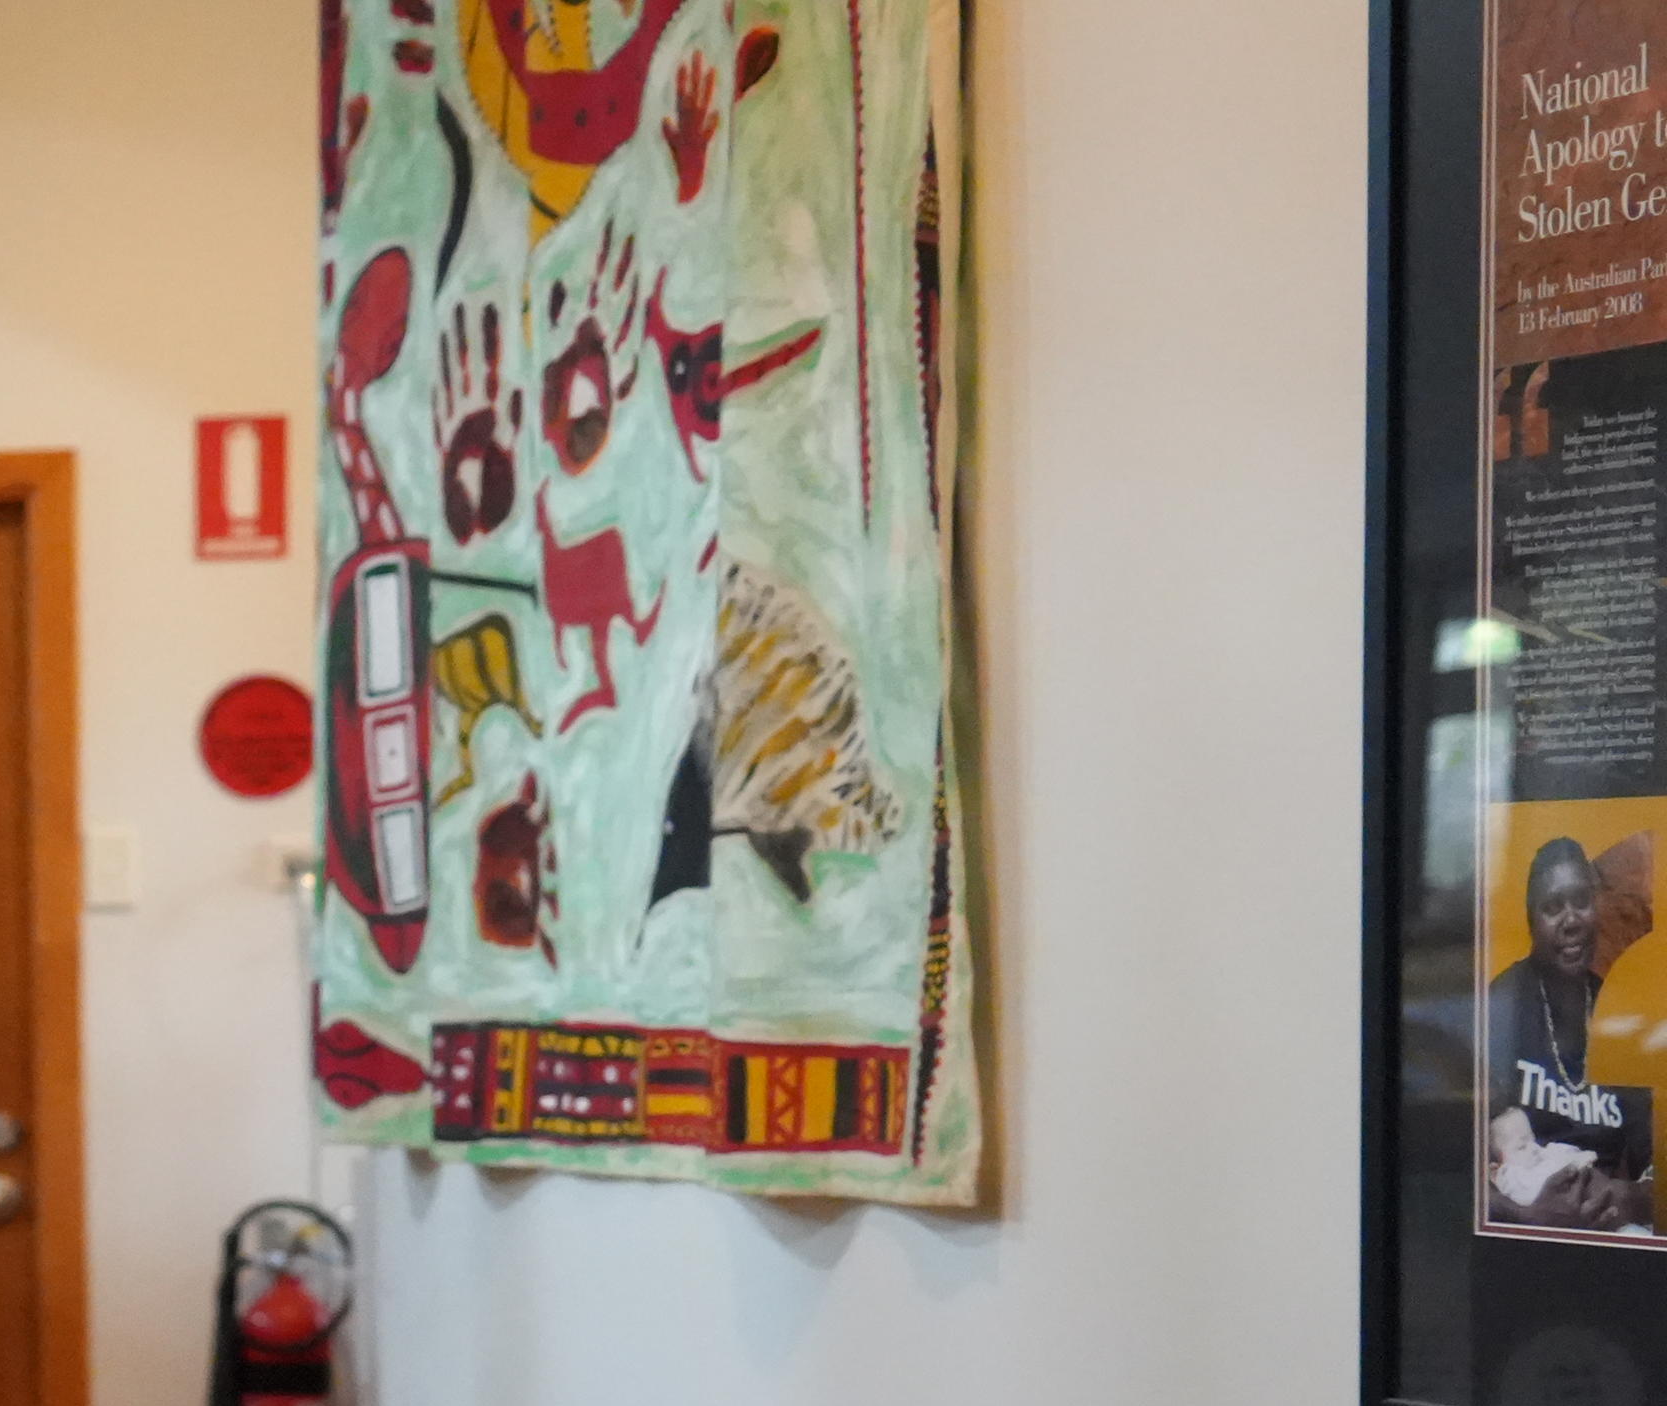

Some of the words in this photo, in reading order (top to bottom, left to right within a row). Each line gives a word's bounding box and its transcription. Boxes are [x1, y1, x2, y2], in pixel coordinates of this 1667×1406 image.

[1520, 42, 1650, 120] National
[1519, 114, 1646, 186] Apology
[1655, 110, 1667, 147] t
[1518, 185, 1612, 243] Stolen
[1621, 172, 1667, 222] Ge
[1517, 280, 1532, 307] by
[1537, 275, 1559, 299] the
[1563, 263, 1637, 294] Australian
[1518, 311, 1535, 334] 13
[1539, 305, 1600, 330] February
[1604, 292, 1643, 319] 2008
[1516, 1060, 1623, 1128] Thanks
